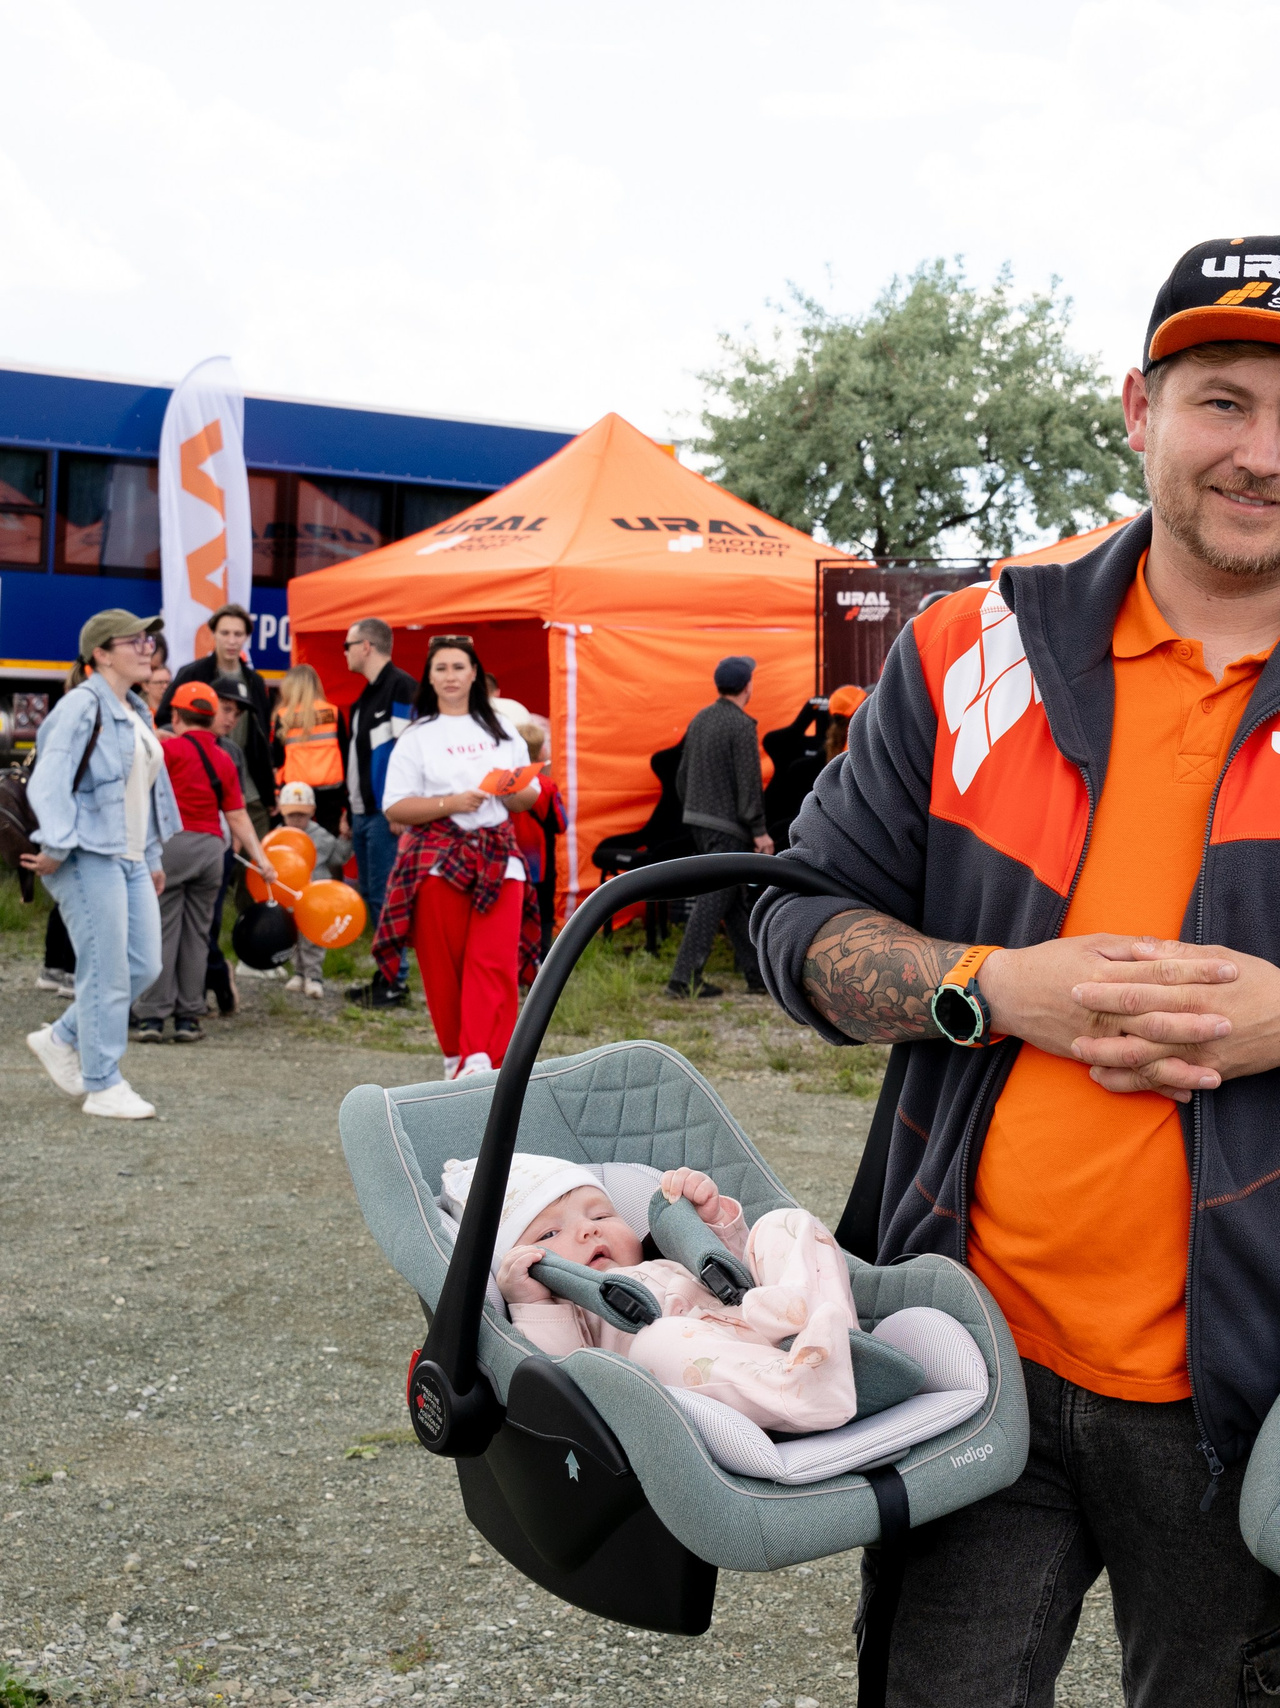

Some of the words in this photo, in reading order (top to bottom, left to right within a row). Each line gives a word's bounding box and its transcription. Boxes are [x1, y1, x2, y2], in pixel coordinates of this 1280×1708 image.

[434, 515, 549, 536] URAL
[611, 516, 782, 540] URAL
[708, 537, 791, 549] MOTOR
[708, 546, 788, 558] SPORT
[836, 591, 891, 606] URAL
[950, 1443, 993, 1469] Indigo
